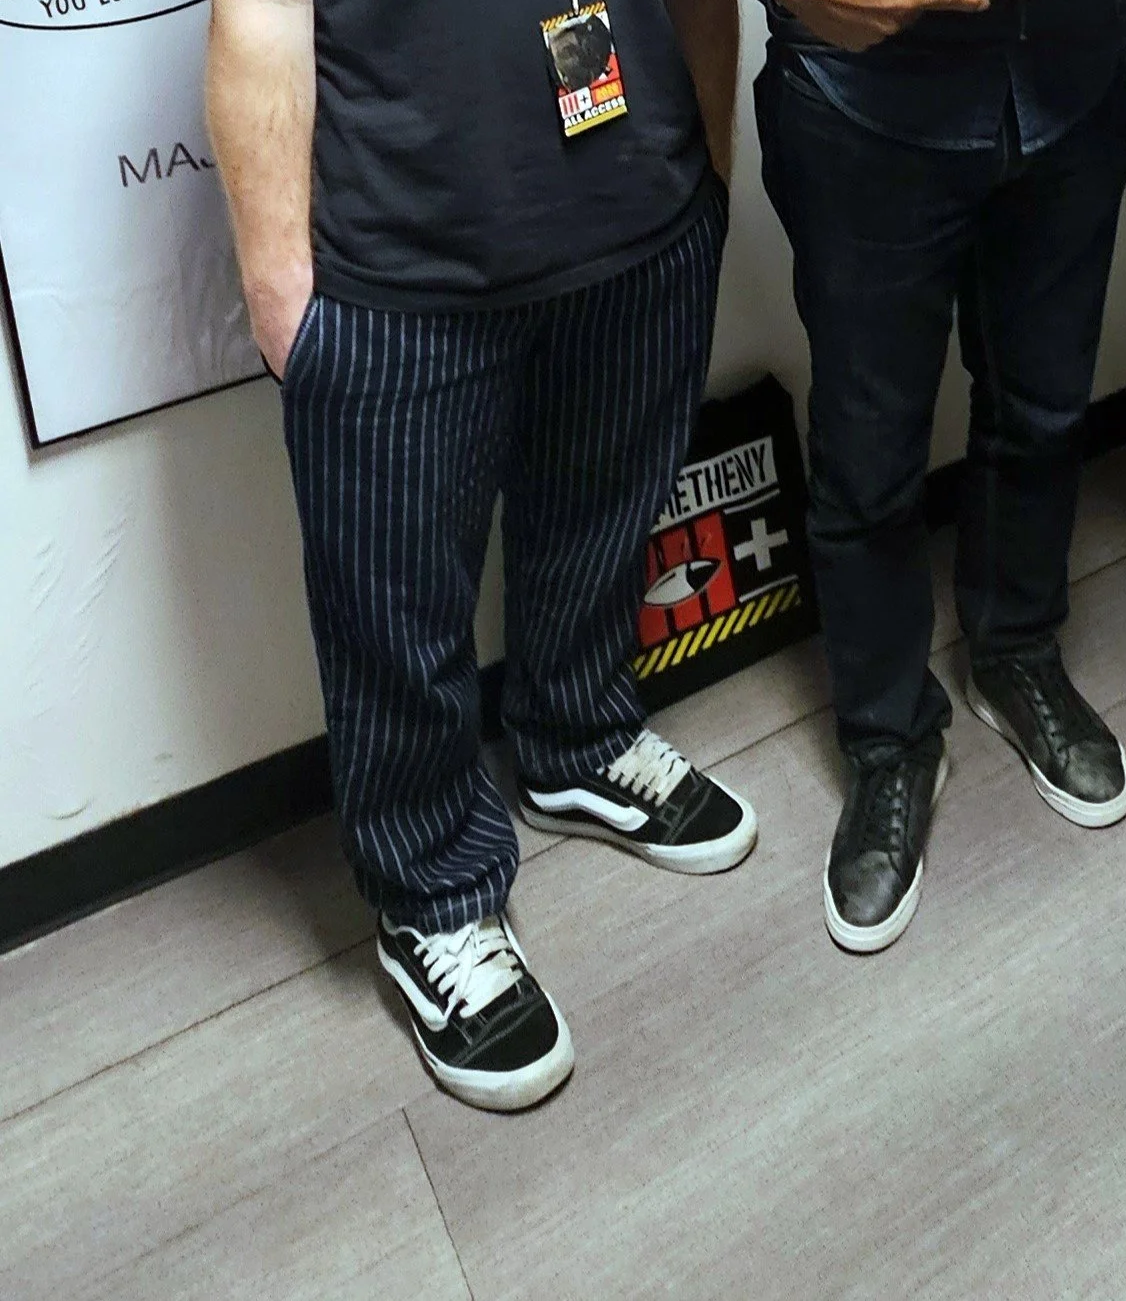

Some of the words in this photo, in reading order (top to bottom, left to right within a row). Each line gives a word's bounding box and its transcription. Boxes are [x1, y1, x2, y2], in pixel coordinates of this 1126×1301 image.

[564, 114, 584, 129] ALL
[585, 95, 626, 119] ACCESS
[667, 443, 767, 520] ETHENY
